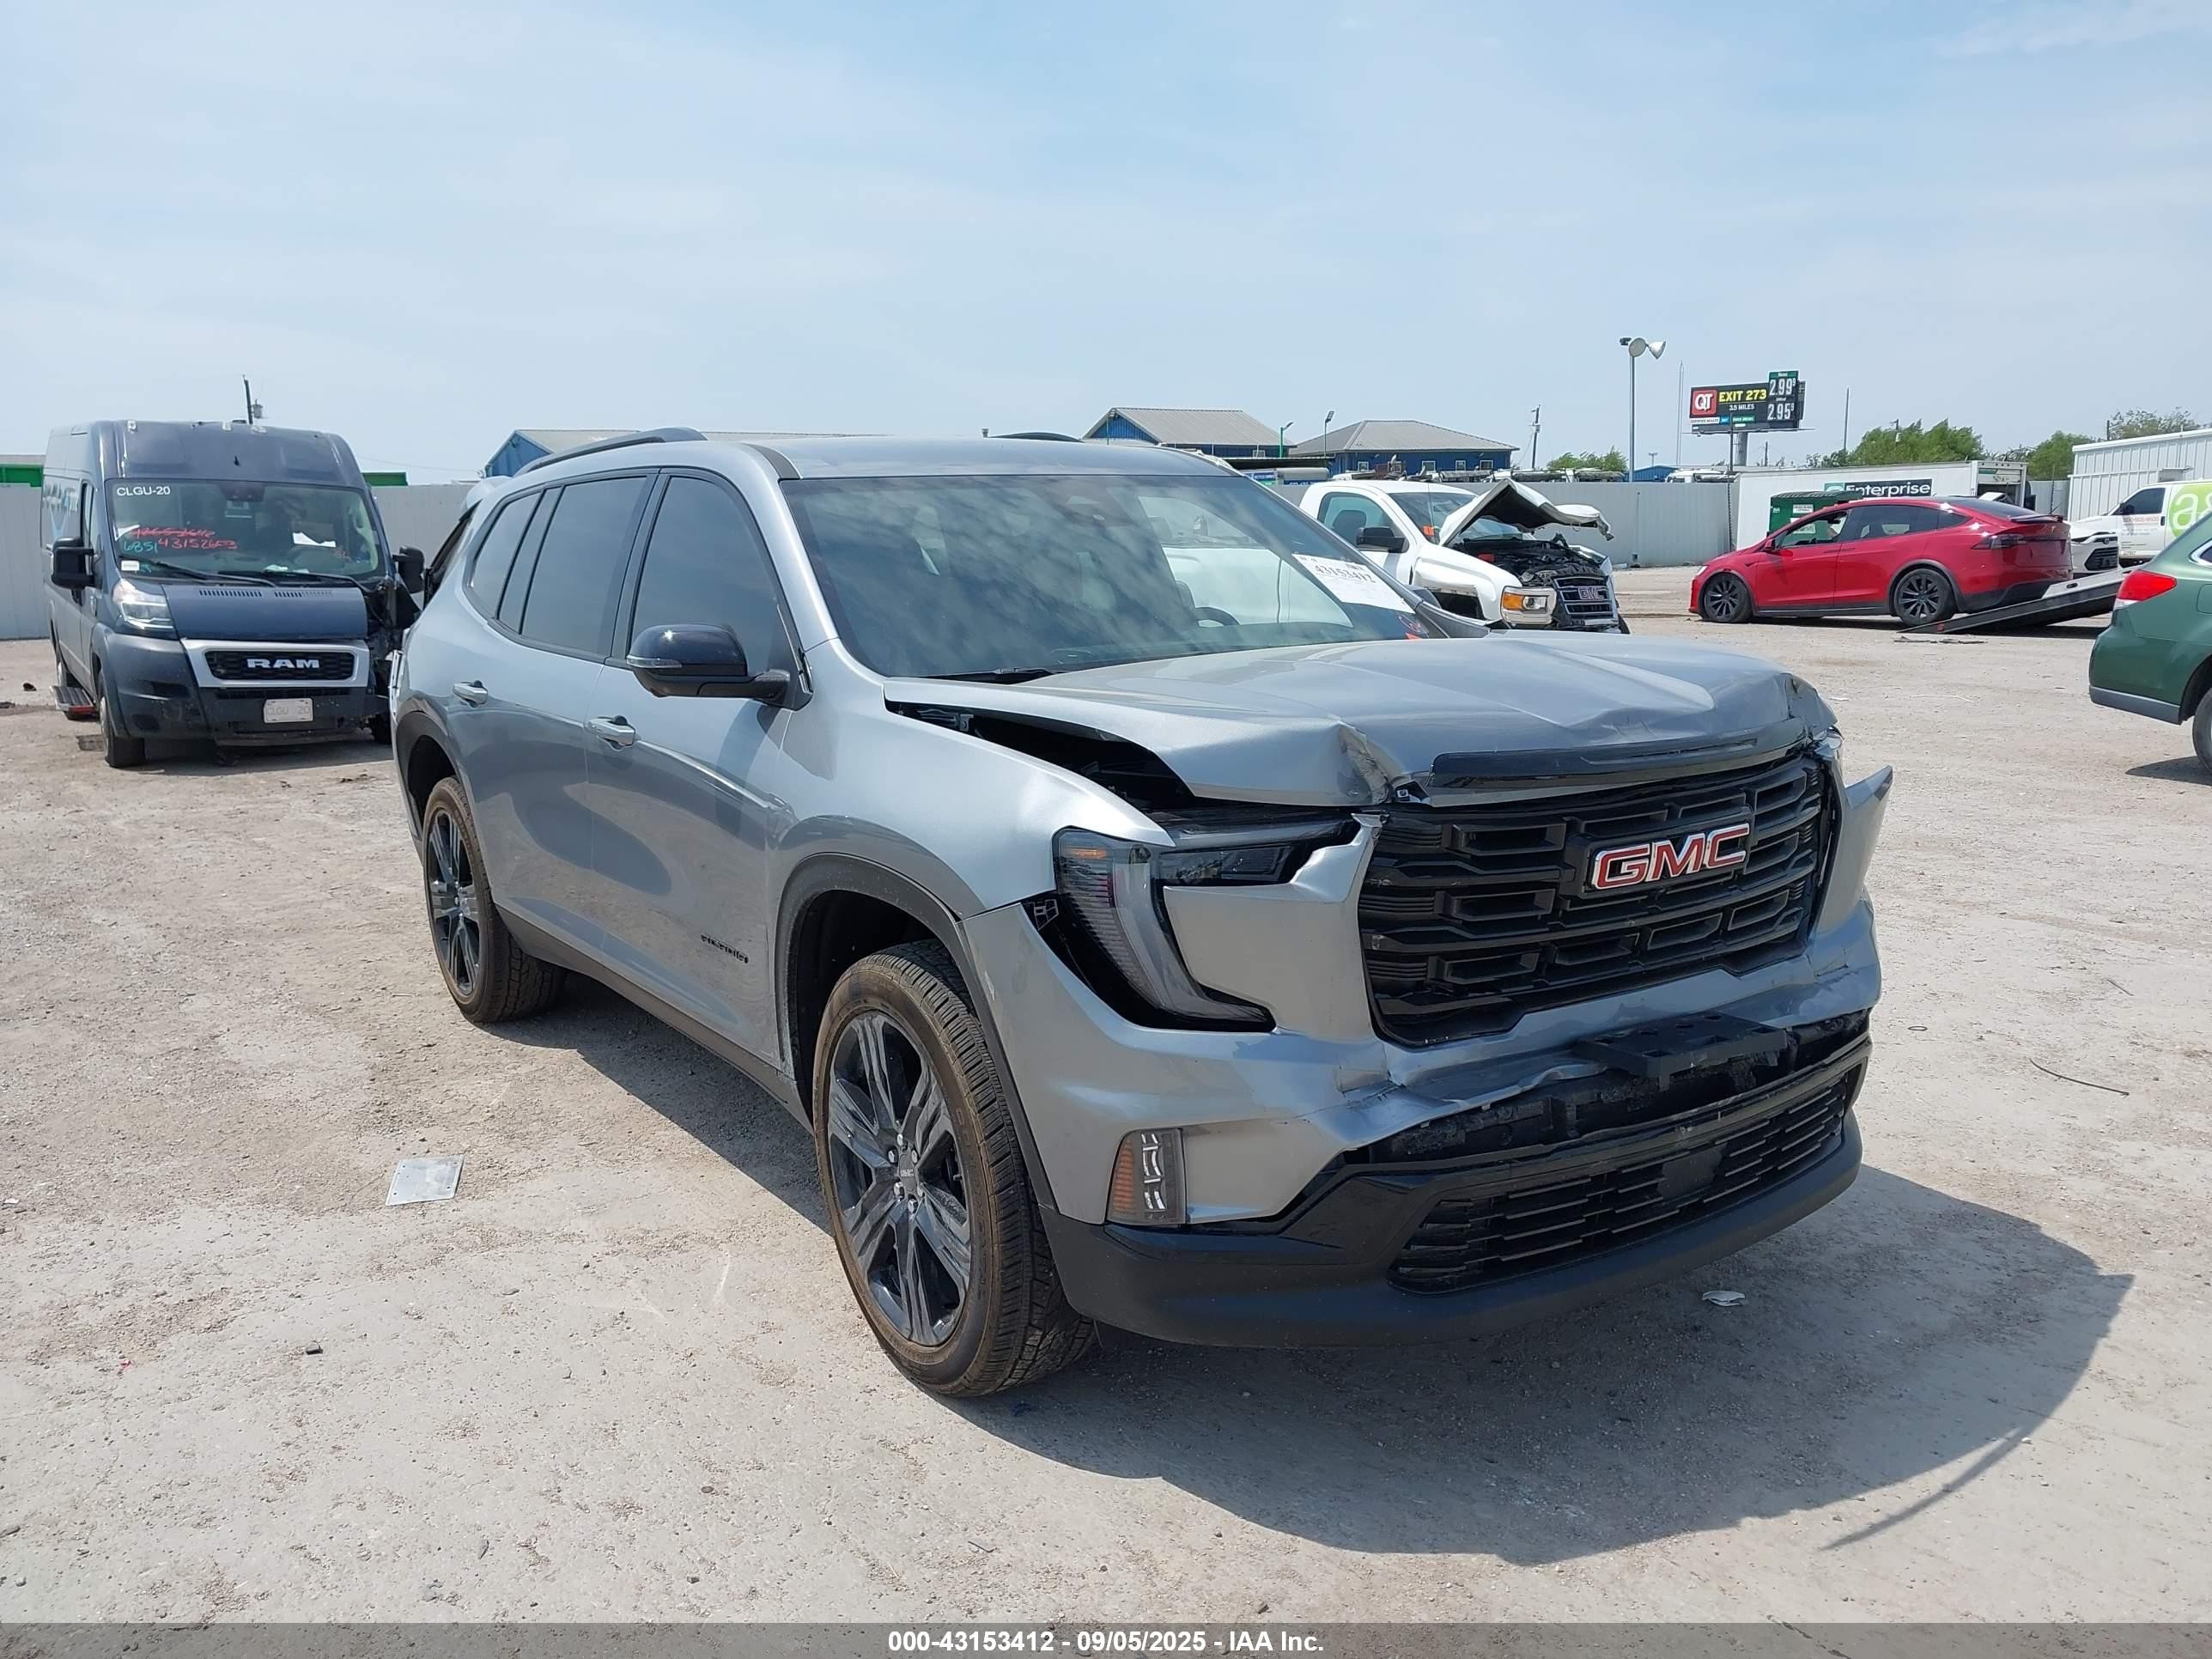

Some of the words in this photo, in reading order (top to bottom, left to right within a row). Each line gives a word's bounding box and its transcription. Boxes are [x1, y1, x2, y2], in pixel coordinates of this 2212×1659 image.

[1694, 393, 1713, 410] QT
[1718, 392, 1743, 402] EXIT
[1746, 389, 1767, 400] 273
[116, 486, 171, 496] CLGU-20
[1315, 564, 1377, 584] 43153412
[1577, 587, 1605, 600] GMC
[246, 658, 320, 668] RAM
[1591, 823, 1750, 890] GMC
